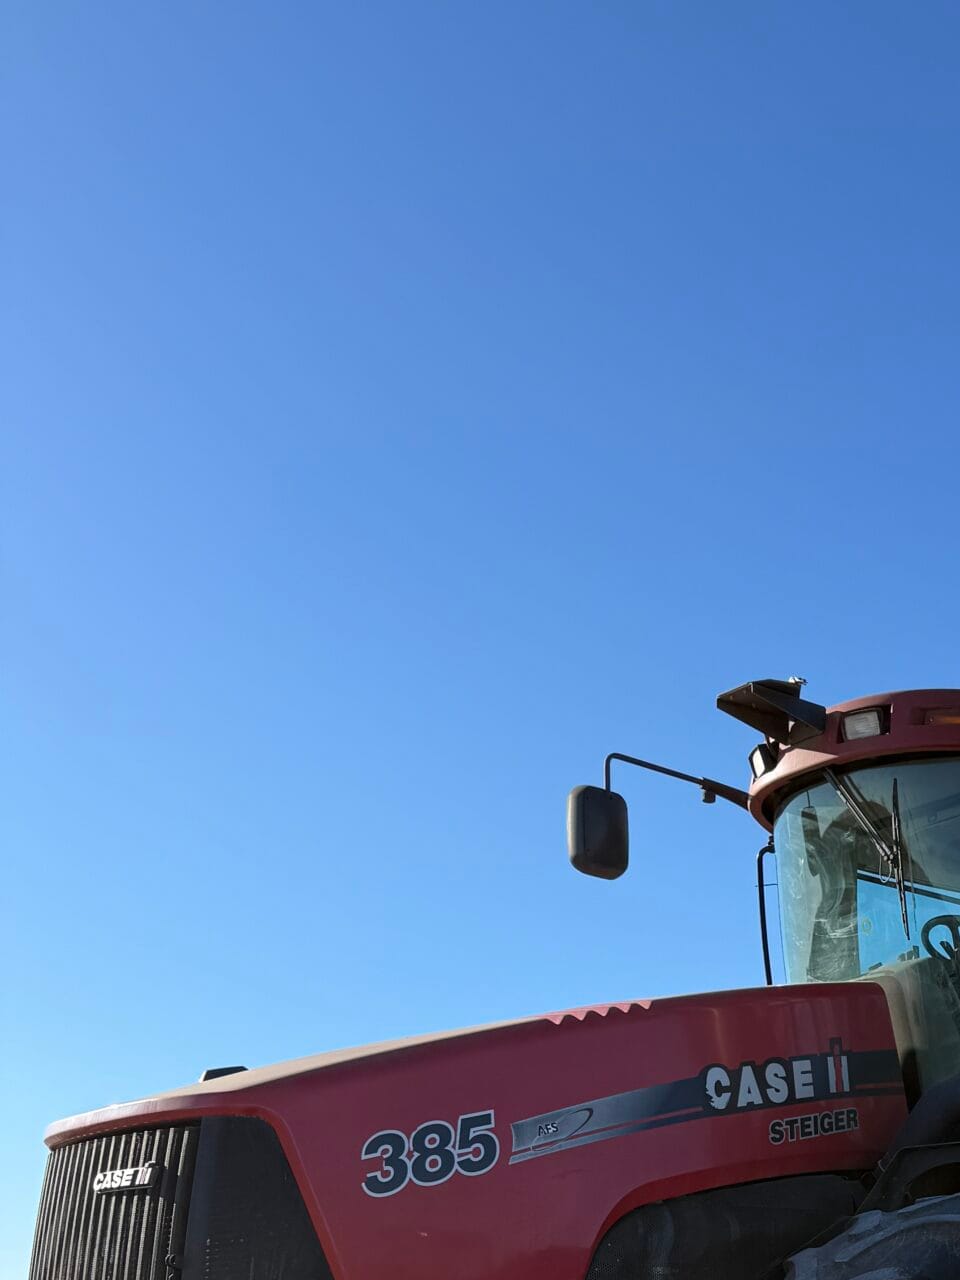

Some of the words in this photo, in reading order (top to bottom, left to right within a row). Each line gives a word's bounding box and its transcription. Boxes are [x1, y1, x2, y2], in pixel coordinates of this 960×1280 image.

[705, 1059, 815, 1110] CASE
[537, 1122, 558, 1137] AFS
[769, 1107, 859, 1145] STEIGER
[361, 1110, 500, 1197] 385
[93, 1169, 134, 1191] CASE
